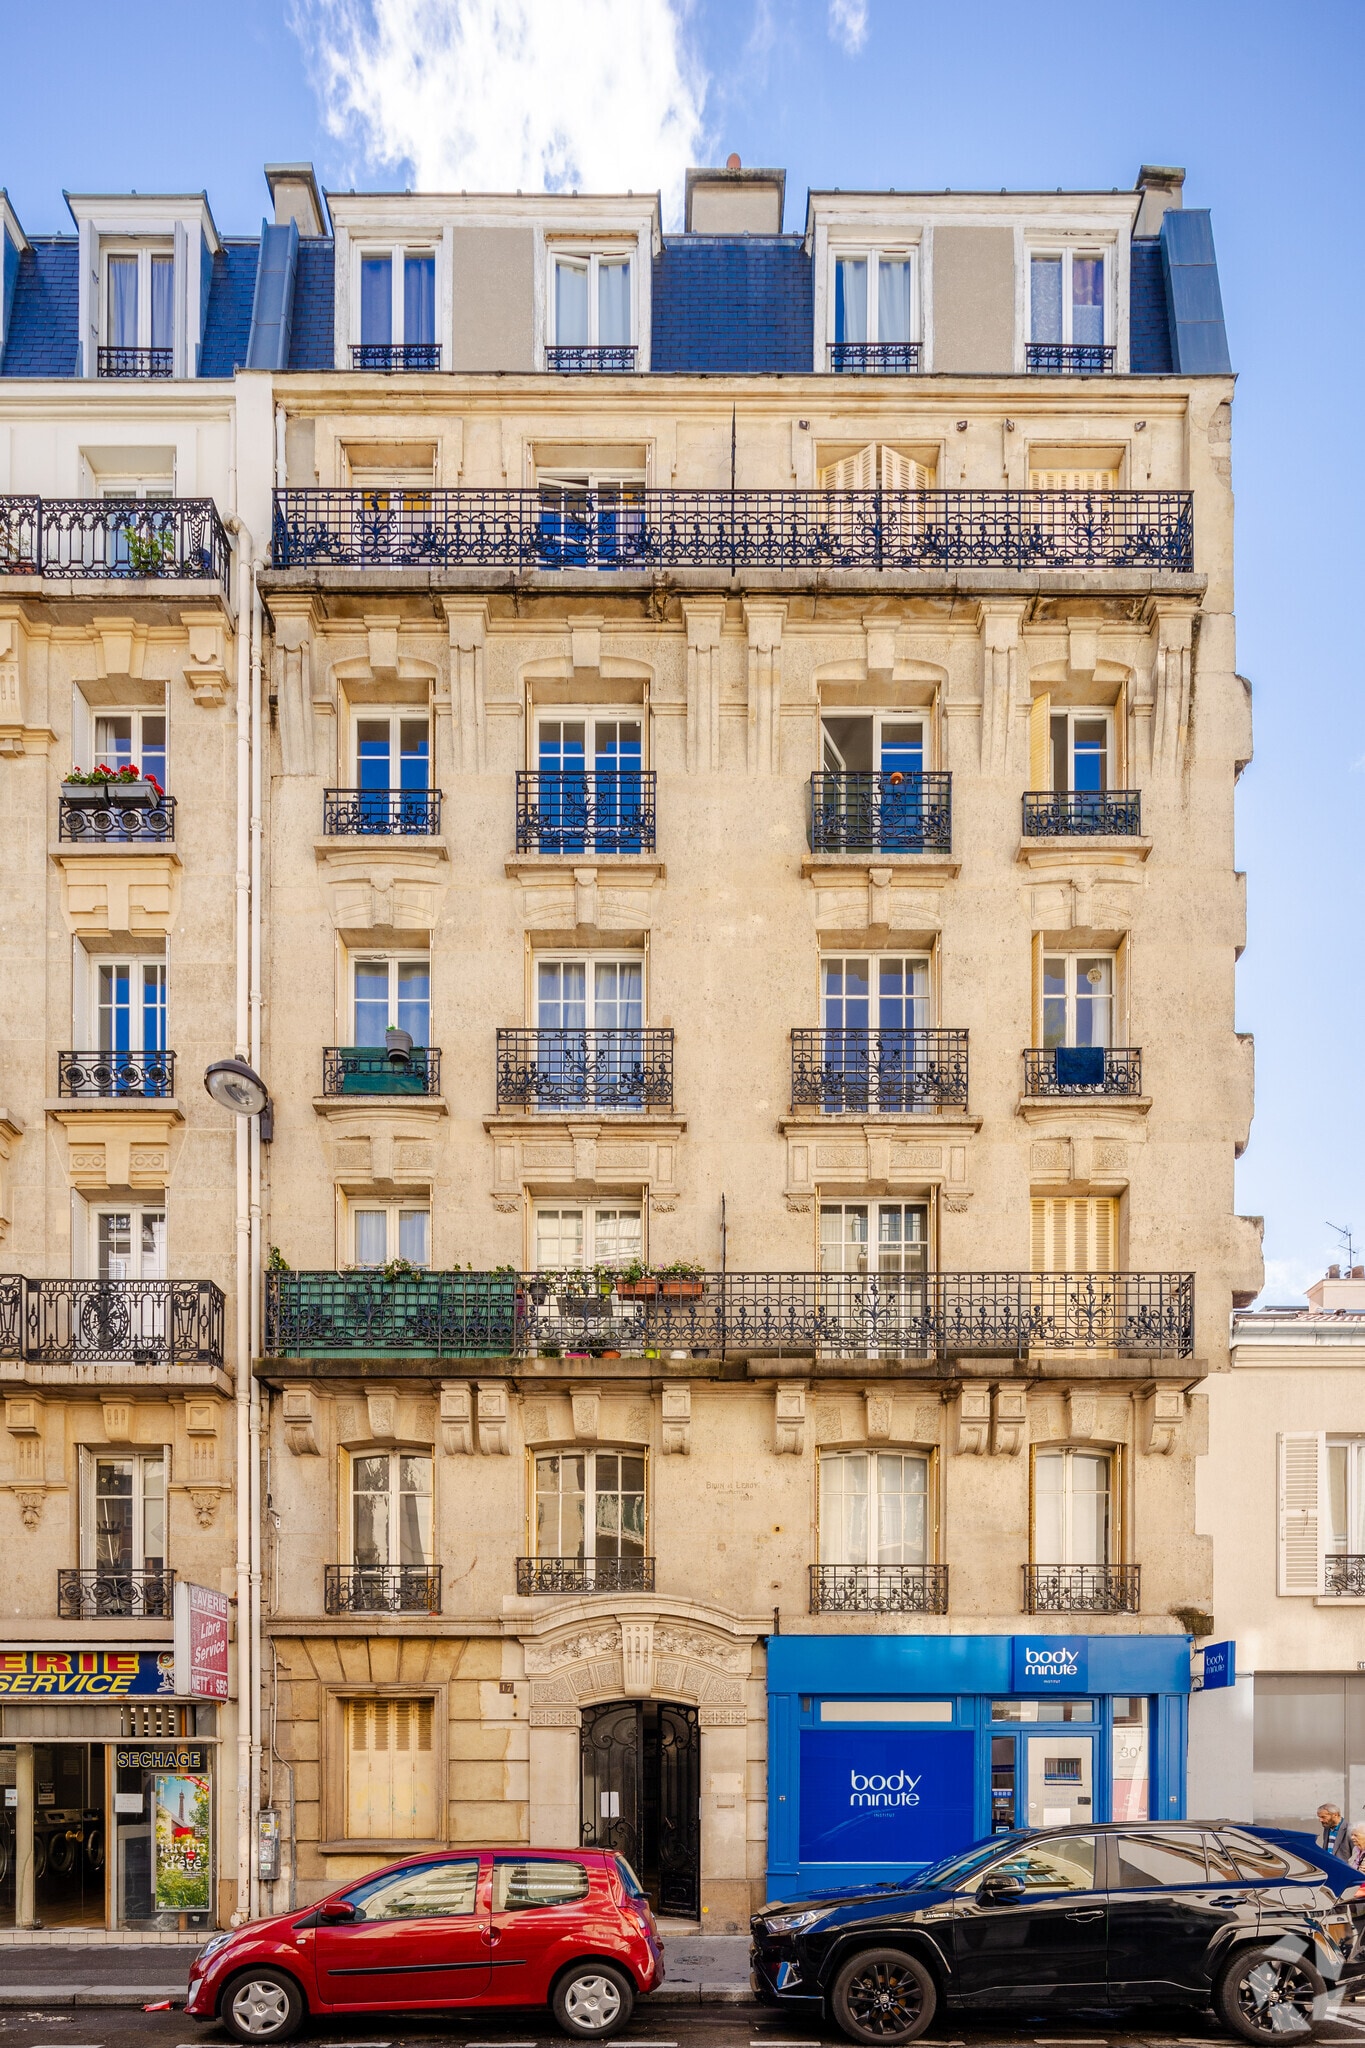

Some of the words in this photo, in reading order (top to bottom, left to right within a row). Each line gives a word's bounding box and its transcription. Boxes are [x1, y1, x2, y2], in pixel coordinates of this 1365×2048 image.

[191, 1587, 227, 1614] LAVERIE
[201, 1620, 221, 1640] Libre
[194, 1640, 225, 1664] Service
[1025, 1647, 1079, 1665] body
[1206, 1652, 1225, 1667] body
[1025, 1664, 1078, 1675] minute
[215, 1678, 228, 1695] SEC
[502, 1684, 512, 1692] 17
[117, 1751, 201, 1768] SECHAGE
[851, 1769, 922, 1792] body
[850, 1792, 920, 1806] minute
[159, 1839, 206, 1857] jardin
[164, 1855, 202, 1870] d'été
